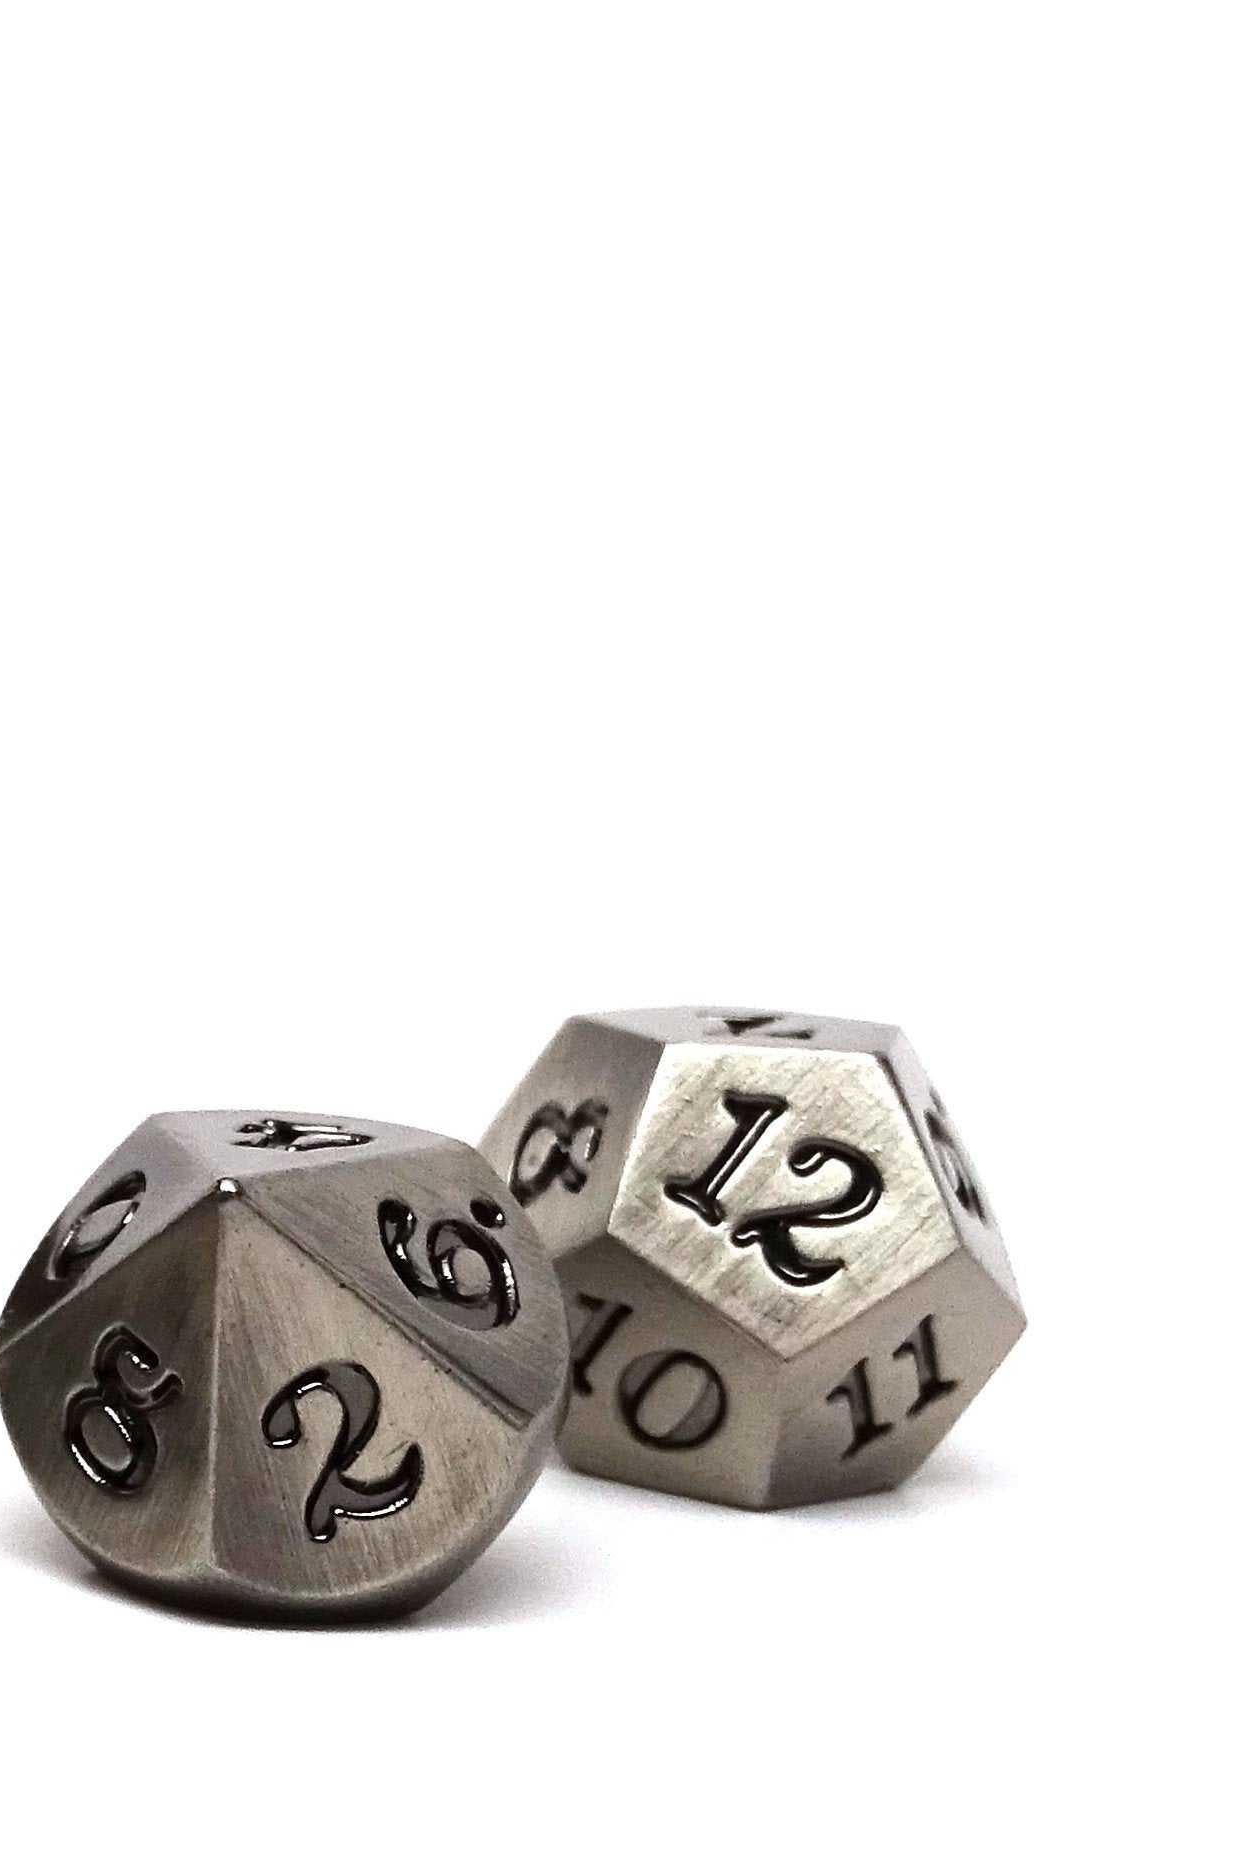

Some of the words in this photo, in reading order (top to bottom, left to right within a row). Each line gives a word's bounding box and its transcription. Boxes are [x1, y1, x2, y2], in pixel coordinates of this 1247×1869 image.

[664, 1090, 884, 1287] 12
[63, 1321, 184, 1494] 8
[261, 1361, 425, 1544] 2
[569, 1294, 727, 1450] 10
[826, 1313, 959, 1462] 11
